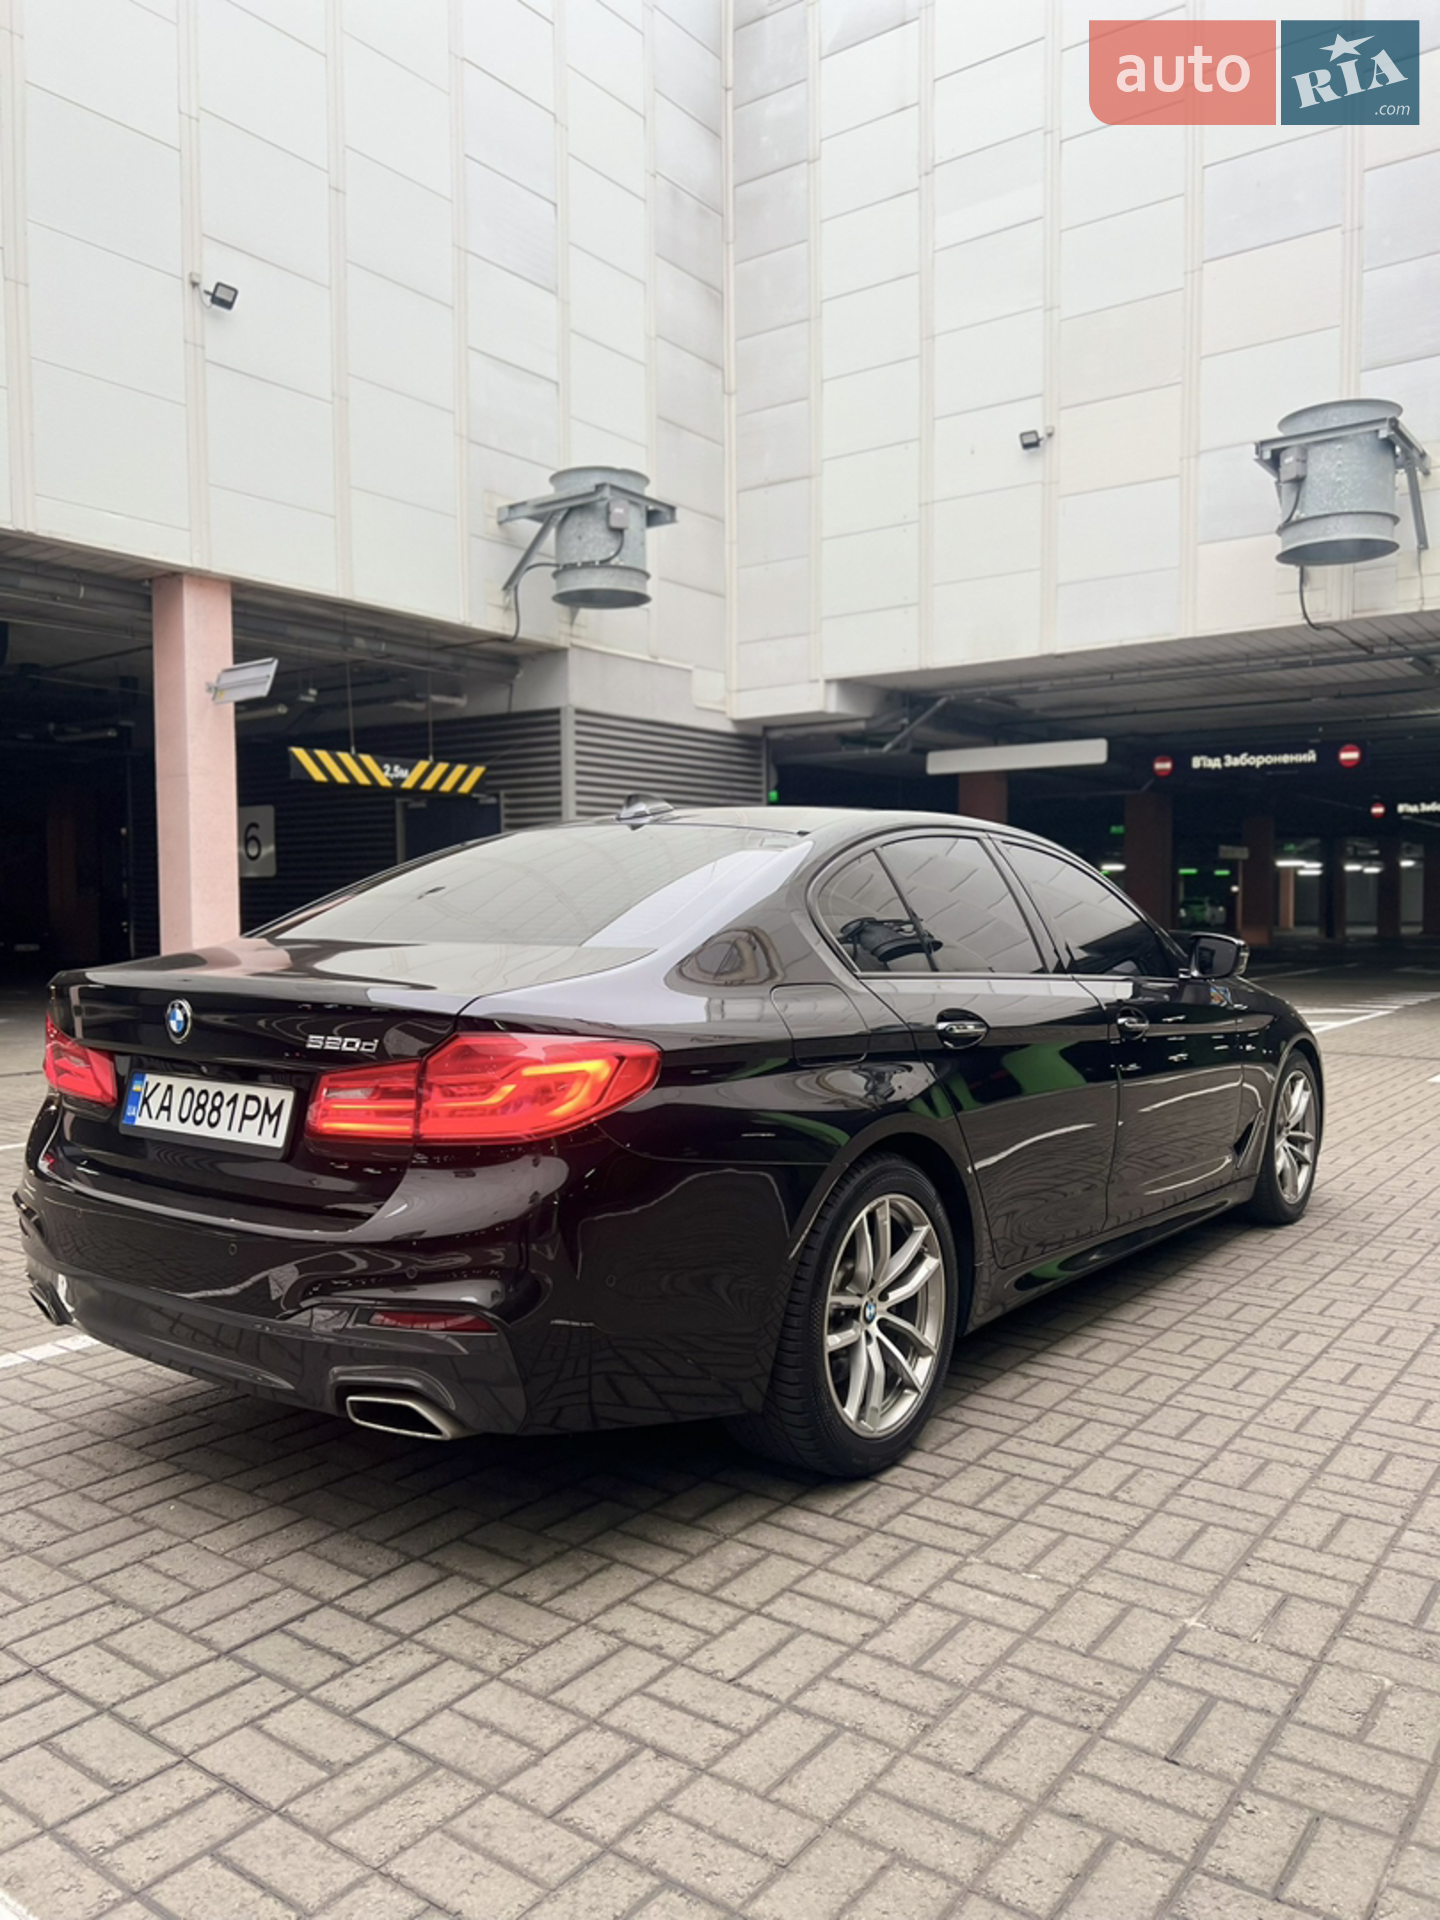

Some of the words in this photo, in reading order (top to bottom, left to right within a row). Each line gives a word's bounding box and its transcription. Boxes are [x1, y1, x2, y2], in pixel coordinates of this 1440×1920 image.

[1223, 749, 1317, 768] Заборонений
[243, 822, 262, 862] 6
[305, 1034, 379, 1053] 520d
